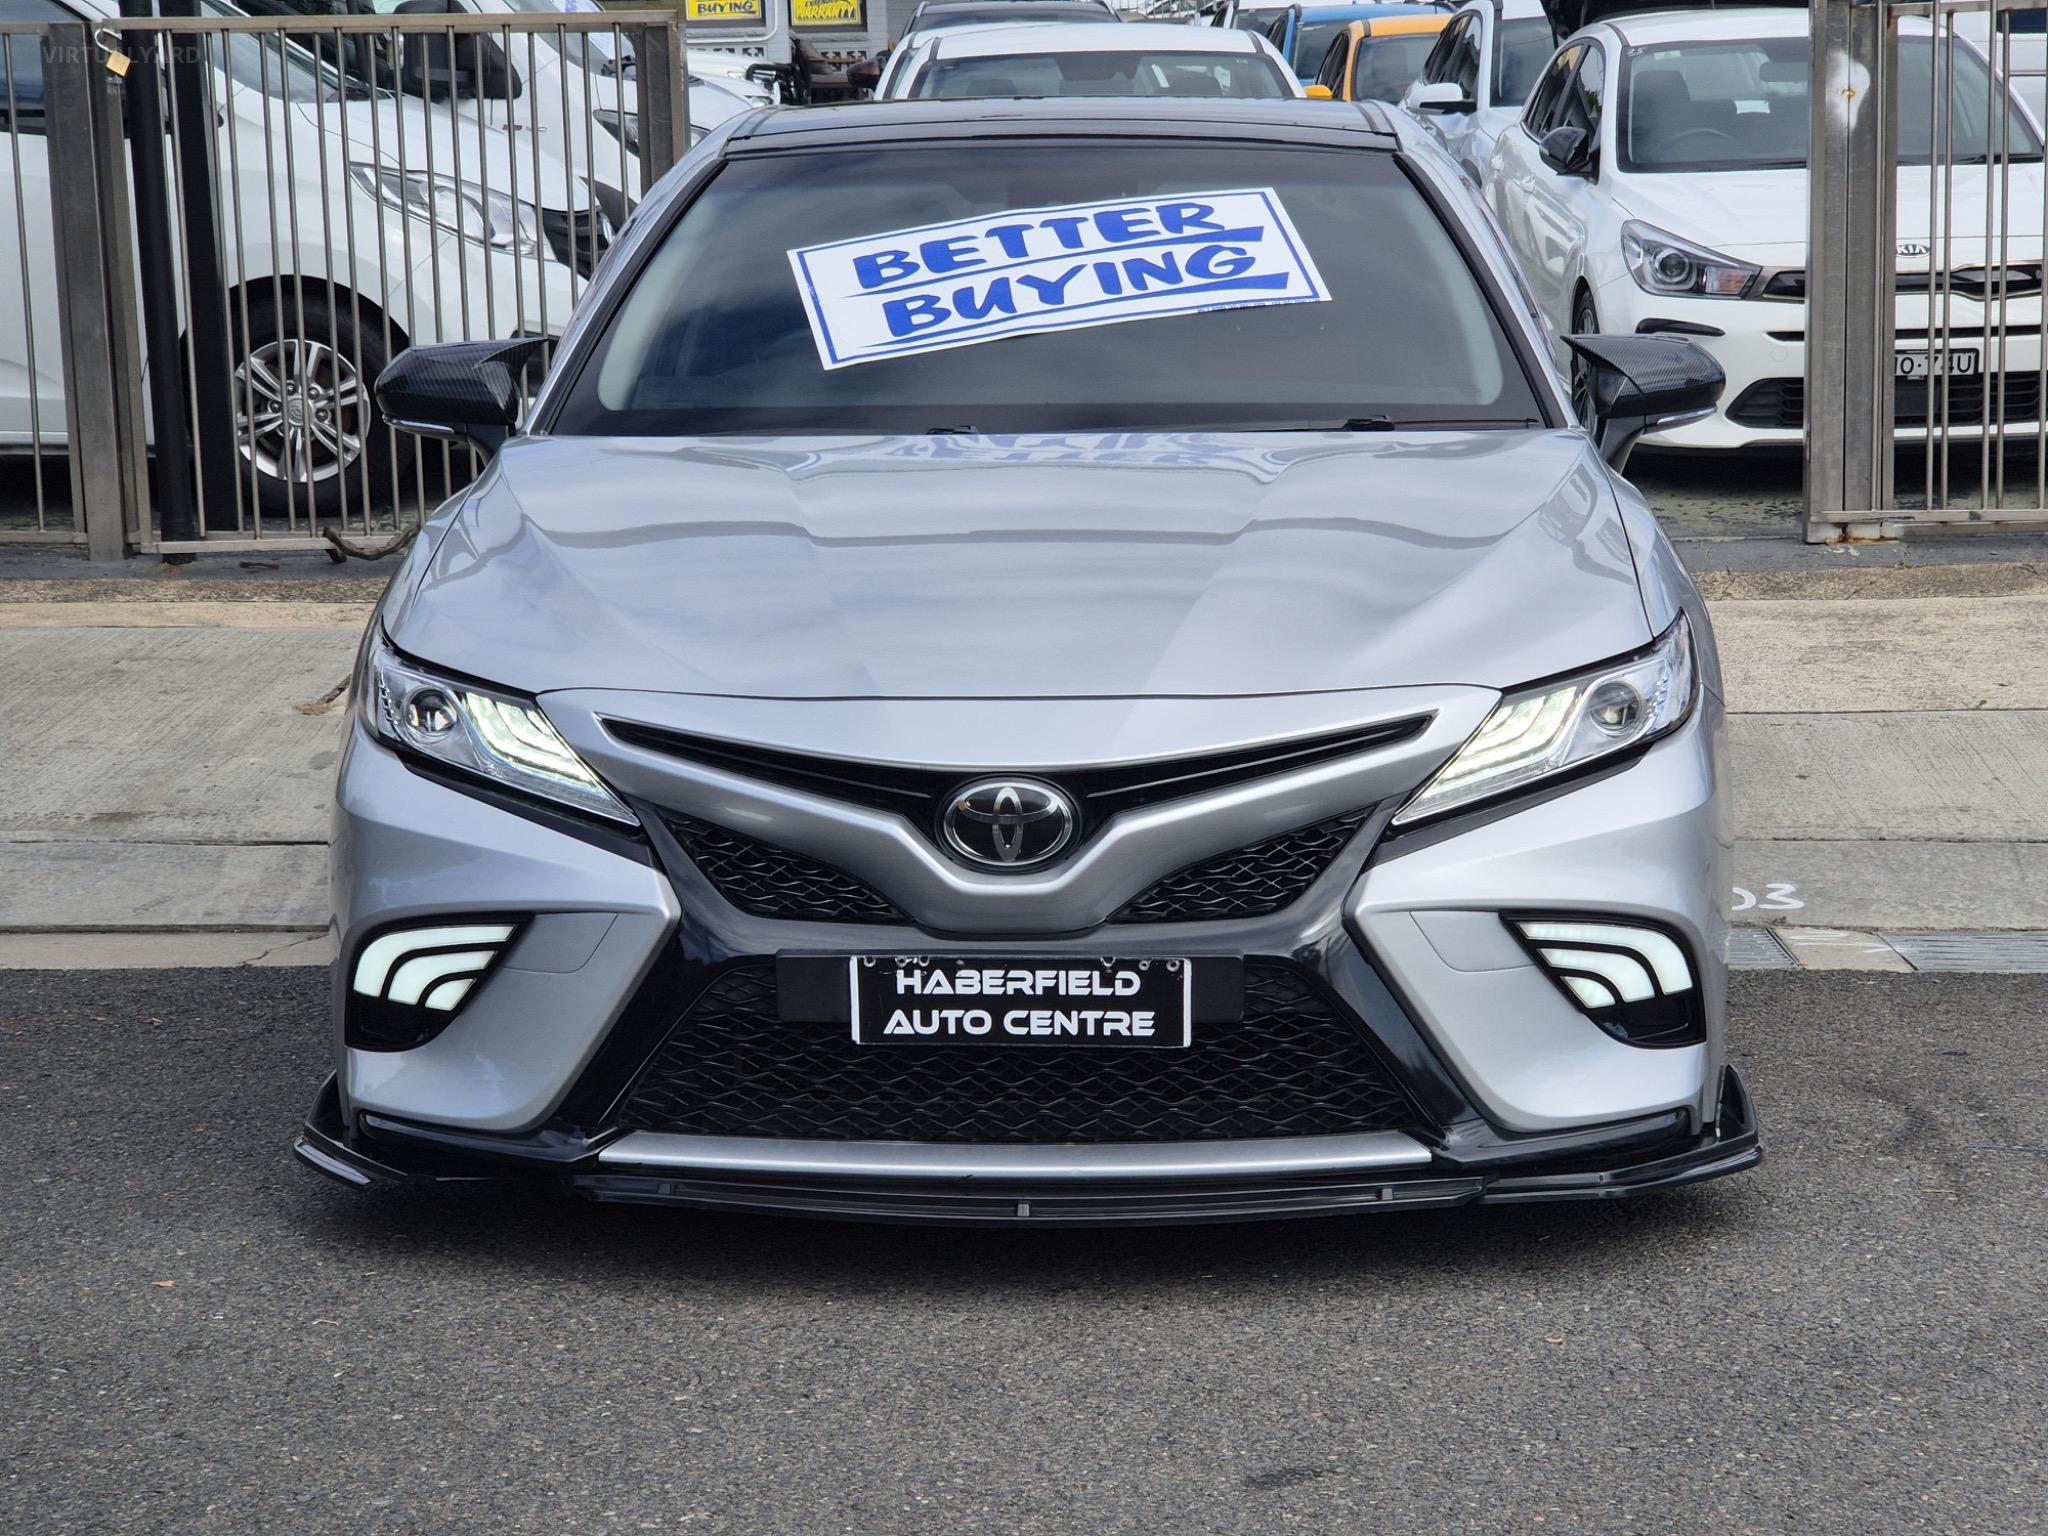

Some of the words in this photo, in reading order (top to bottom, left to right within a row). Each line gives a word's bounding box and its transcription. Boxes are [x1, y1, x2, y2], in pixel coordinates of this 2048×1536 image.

[697, 1, 754, 15] BUYING
[852, 202, 1226, 290] BETTER
[1897, 244, 1927, 254] KIA
[881, 244, 1257, 338] BUYING
[896, 969, 1141, 996] HABERFIELD
[883, 1009, 992, 1035] AUTO
[1003, 1010, 1156, 1037] CENTRE
